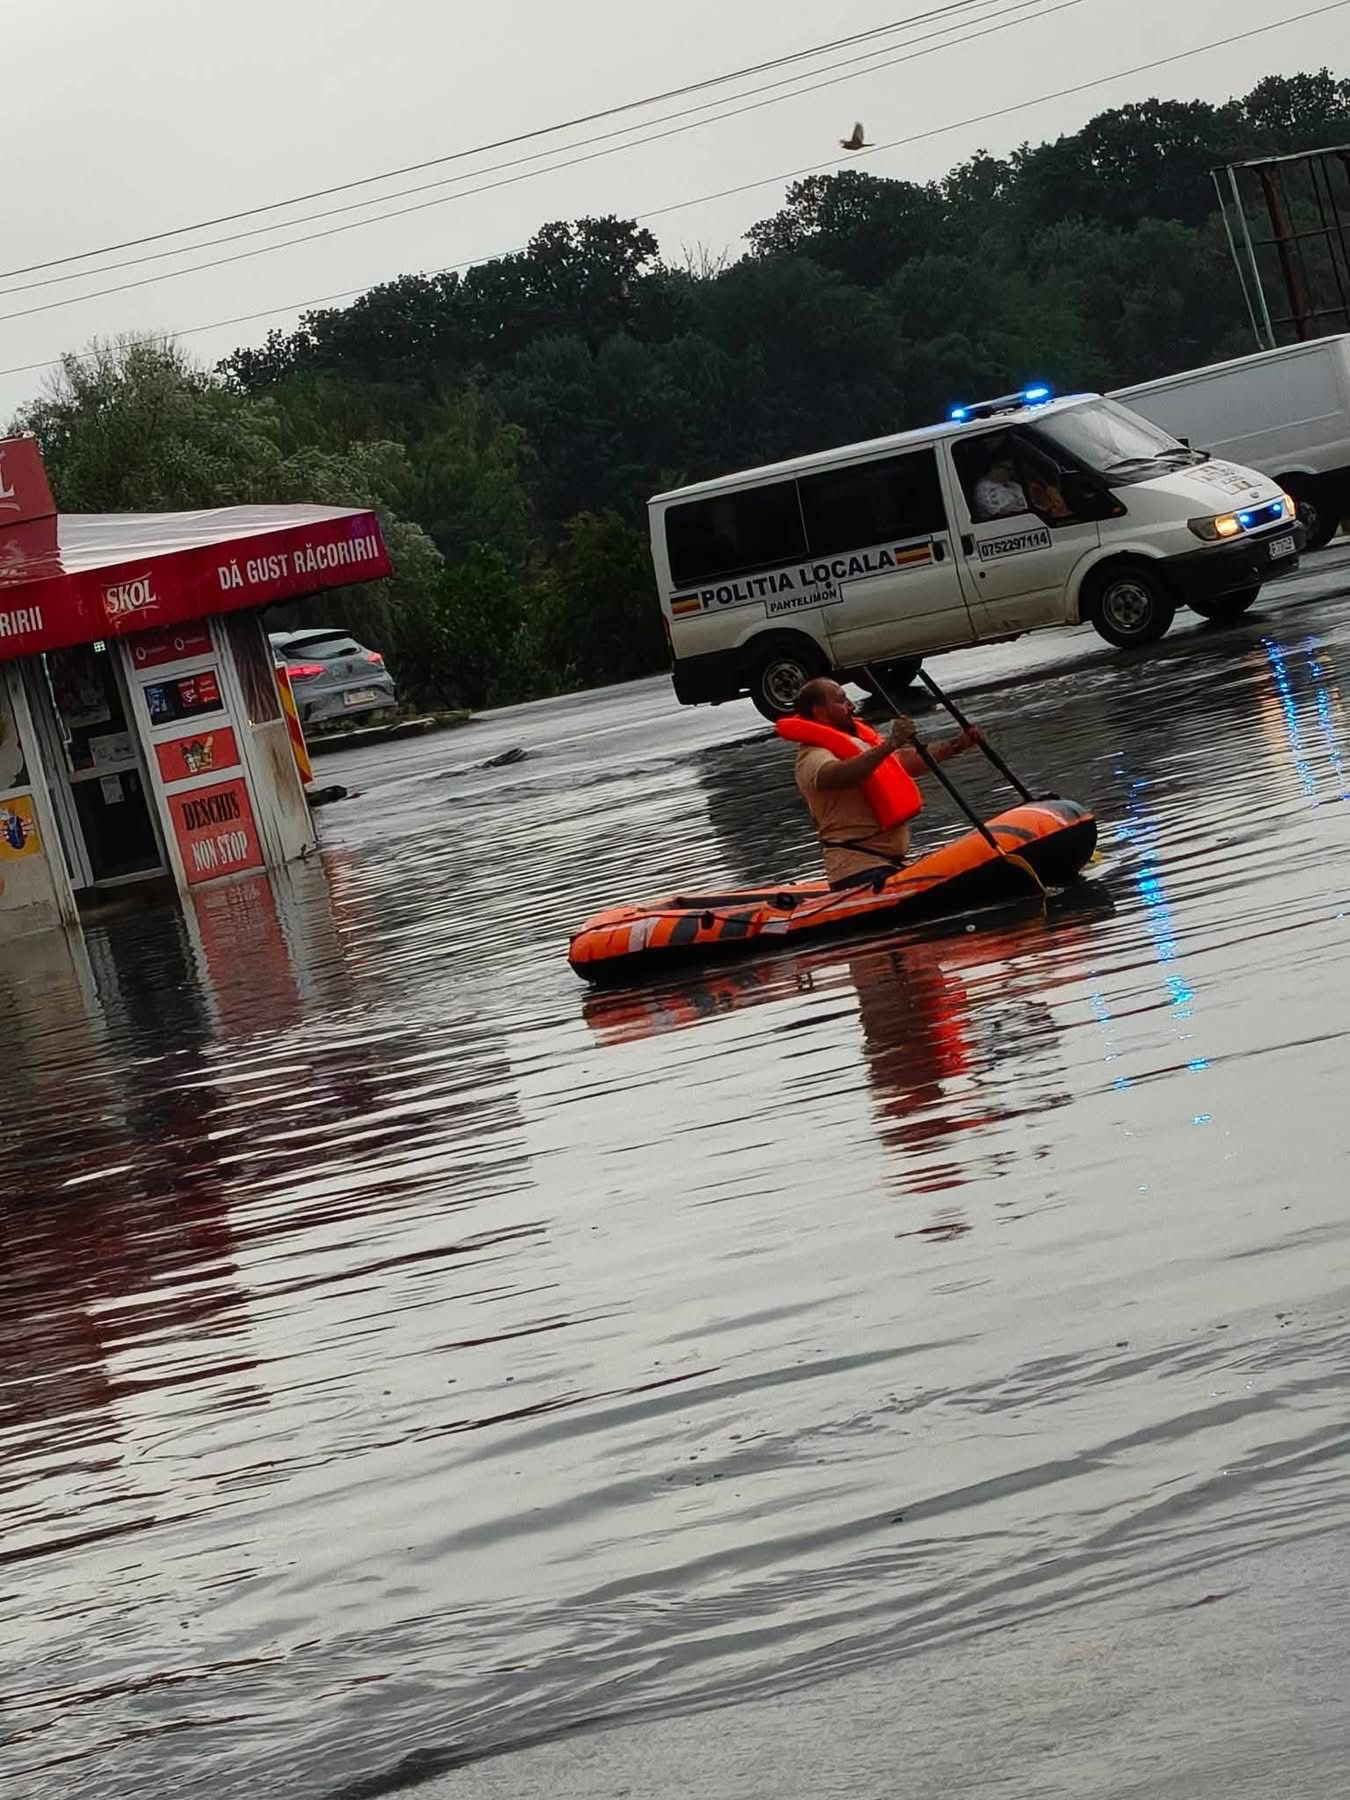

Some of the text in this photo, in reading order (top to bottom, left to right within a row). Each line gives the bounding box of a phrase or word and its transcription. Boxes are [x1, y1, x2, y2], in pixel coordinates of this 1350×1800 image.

[218, 535, 379, 590] DĂ GUST RĂCORIRII
[982, 532, 1047, 556] 0752297114
[105, 578, 157, 615] SKOL
[701, 550, 896, 608] POLITIA LOCALA
[770, 589, 837, 612] PANTELIMON
[182, 791, 240, 831] DESCHIS
